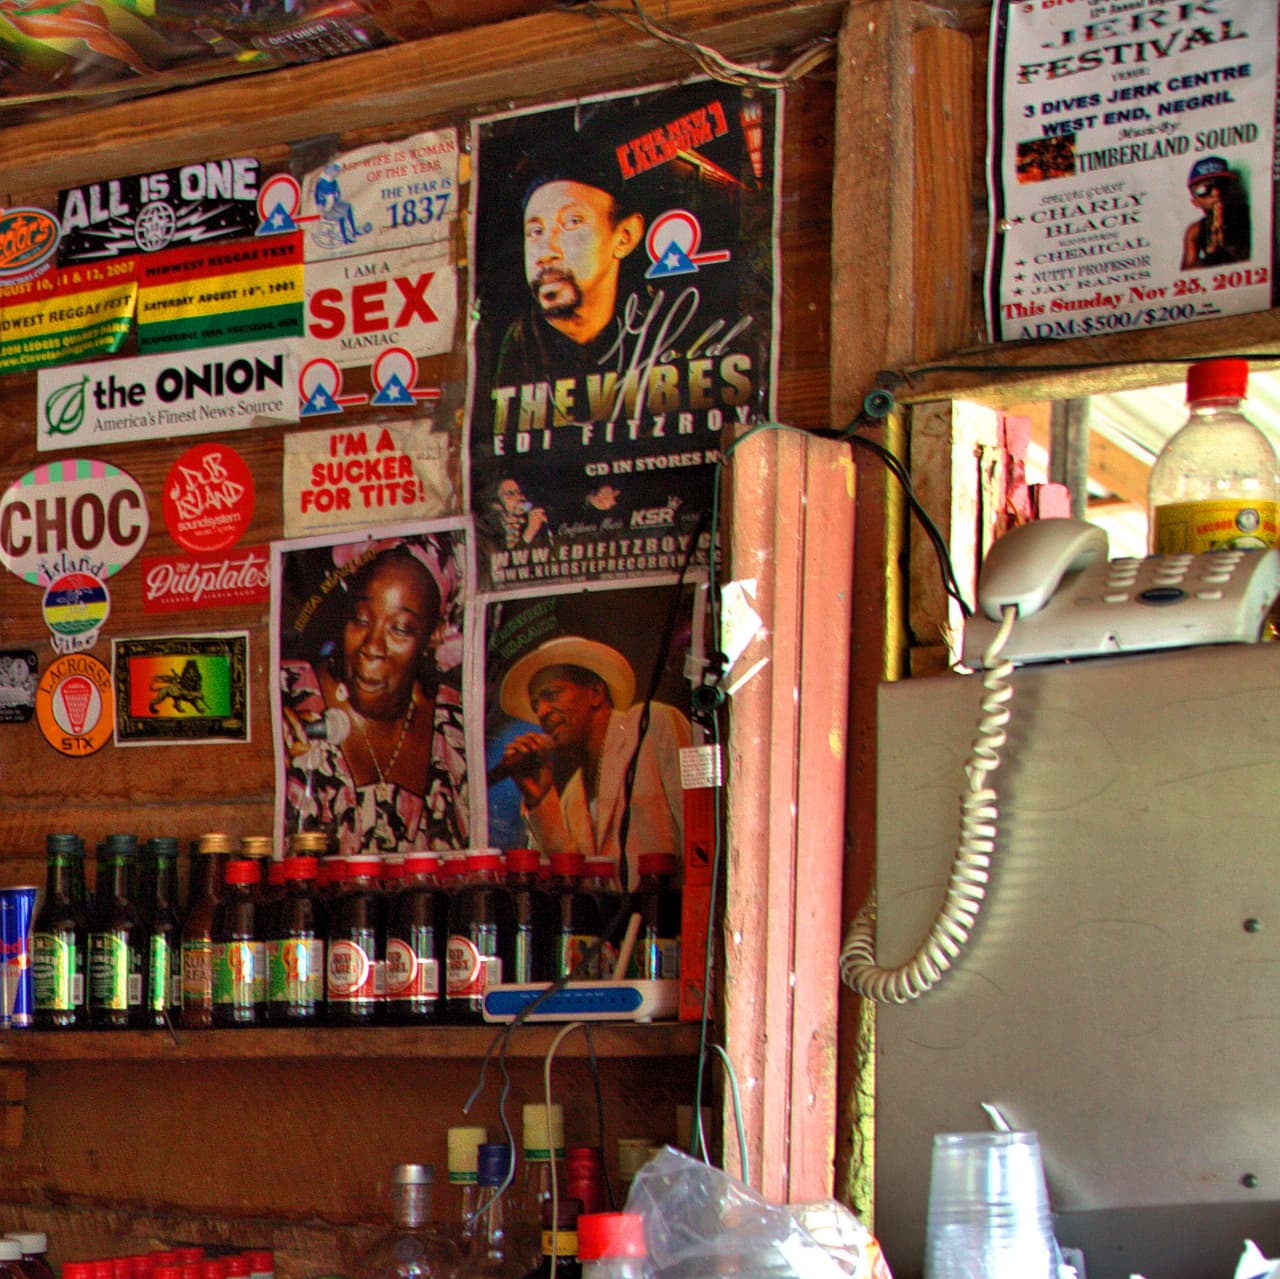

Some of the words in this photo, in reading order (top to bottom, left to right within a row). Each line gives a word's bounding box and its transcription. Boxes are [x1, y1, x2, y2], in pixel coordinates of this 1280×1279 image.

[1016, 19, 1250, 85] FESTIVAL
[1023, 105, 1036, 119] 3
[1041, 93, 1102, 116] DIVES
[1107, 81, 1162, 103] JERK
[1167, 63, 1252, 92] CENTRE
[1041, 115, 1098, 138] WEST
[1103, 106, 1152, 127] END,
[1157, 90, 1236, 116] NEGRIL
[361, 153, 391, 168] WIFE
[394, 151, 408, 163] IS
[409, 141, 455, 161] WOMAN
[1076, 135, 1191, 174] TIMBERLAND
[1195, 122, 1260, 152] SOUND
[366, 170, 383, 183] OF
[385, 166, 408, 180] THE
[411, 159, 443, 175] YEAR
[60, 180, 131, 237] ALL
[141, 173, 172, 204] IS
[179, 158, 259, 201] ONE
[381, 187, 404, 201] THE
[406, 180, 439, 197] YEAR
[441, 178, 453, 190] IS
[387, 192, 453, 229] 1837
[1030, 192, 1148, 225] CHARLY
[1044, 211, 1142, 239] BLACK
[145, 259, 204, 277] MIDWEST
[208, 250, 259, 267] REGGAE
[263, 244, 296, 258] FEST
[1033, 238, 1152, 265] CHEMICAL
[107, 261, 136, 277] 2007
[352, 263, 378, 279] AM
[381, 261, 392, 274] A
[1031, 283, 1074, 296] JAY
[1078, 271, 1152, 290] RANKS
[1032, 267, 1076, 284] NUTTY
[1078, 255, 1152, 278] PROFESSOR
[144, 296, 194, 312] SATURDAY
[198, 290, 238, 303] AUGUST
[308, 272, 440, 340] SEX
[1001, 301, 1046, 321] This
[1050, 292, 1124, 316] Sunday
[1128, 284, 1168, 304] Nov
[1212, 267, 1269, 291] 2012
[340, 332, 401, 351] MANIAC
[94, 375, 147, 411] the
[155, 354, 285, 403] ONION
[491, 377, 577, 434] THE
[586, 353, 754, 424] VIBES
[93, 411, 158, 433] America's
[158, 407, 198, 426] Finest
[199, 403, 236, 421] News
[237, 399, 283, 418] Source
[493, 429, 552, 456] EDI
[582, 403, 752, 446] FITZROY
[329, 431, 368, 458] I'M
[375, 428, 397, 454] A
[311, 455, 416, 488] SUCKER
[585, 462, 611, 477] CD
[613, 460, 633, 474] IN
[636, 452, 702, 471] STORES
[301, 487, 352, 514] FOR
[358, 479, 427, 509] TITS!
[177, 512, 241, 532] soundsystem
[630, 507, 675, 529] KSR
[146, 552, 272, 603] Dubplates
[40, 656, 113, 696] LACROSSE
[61, 736, 95, 751] STX
